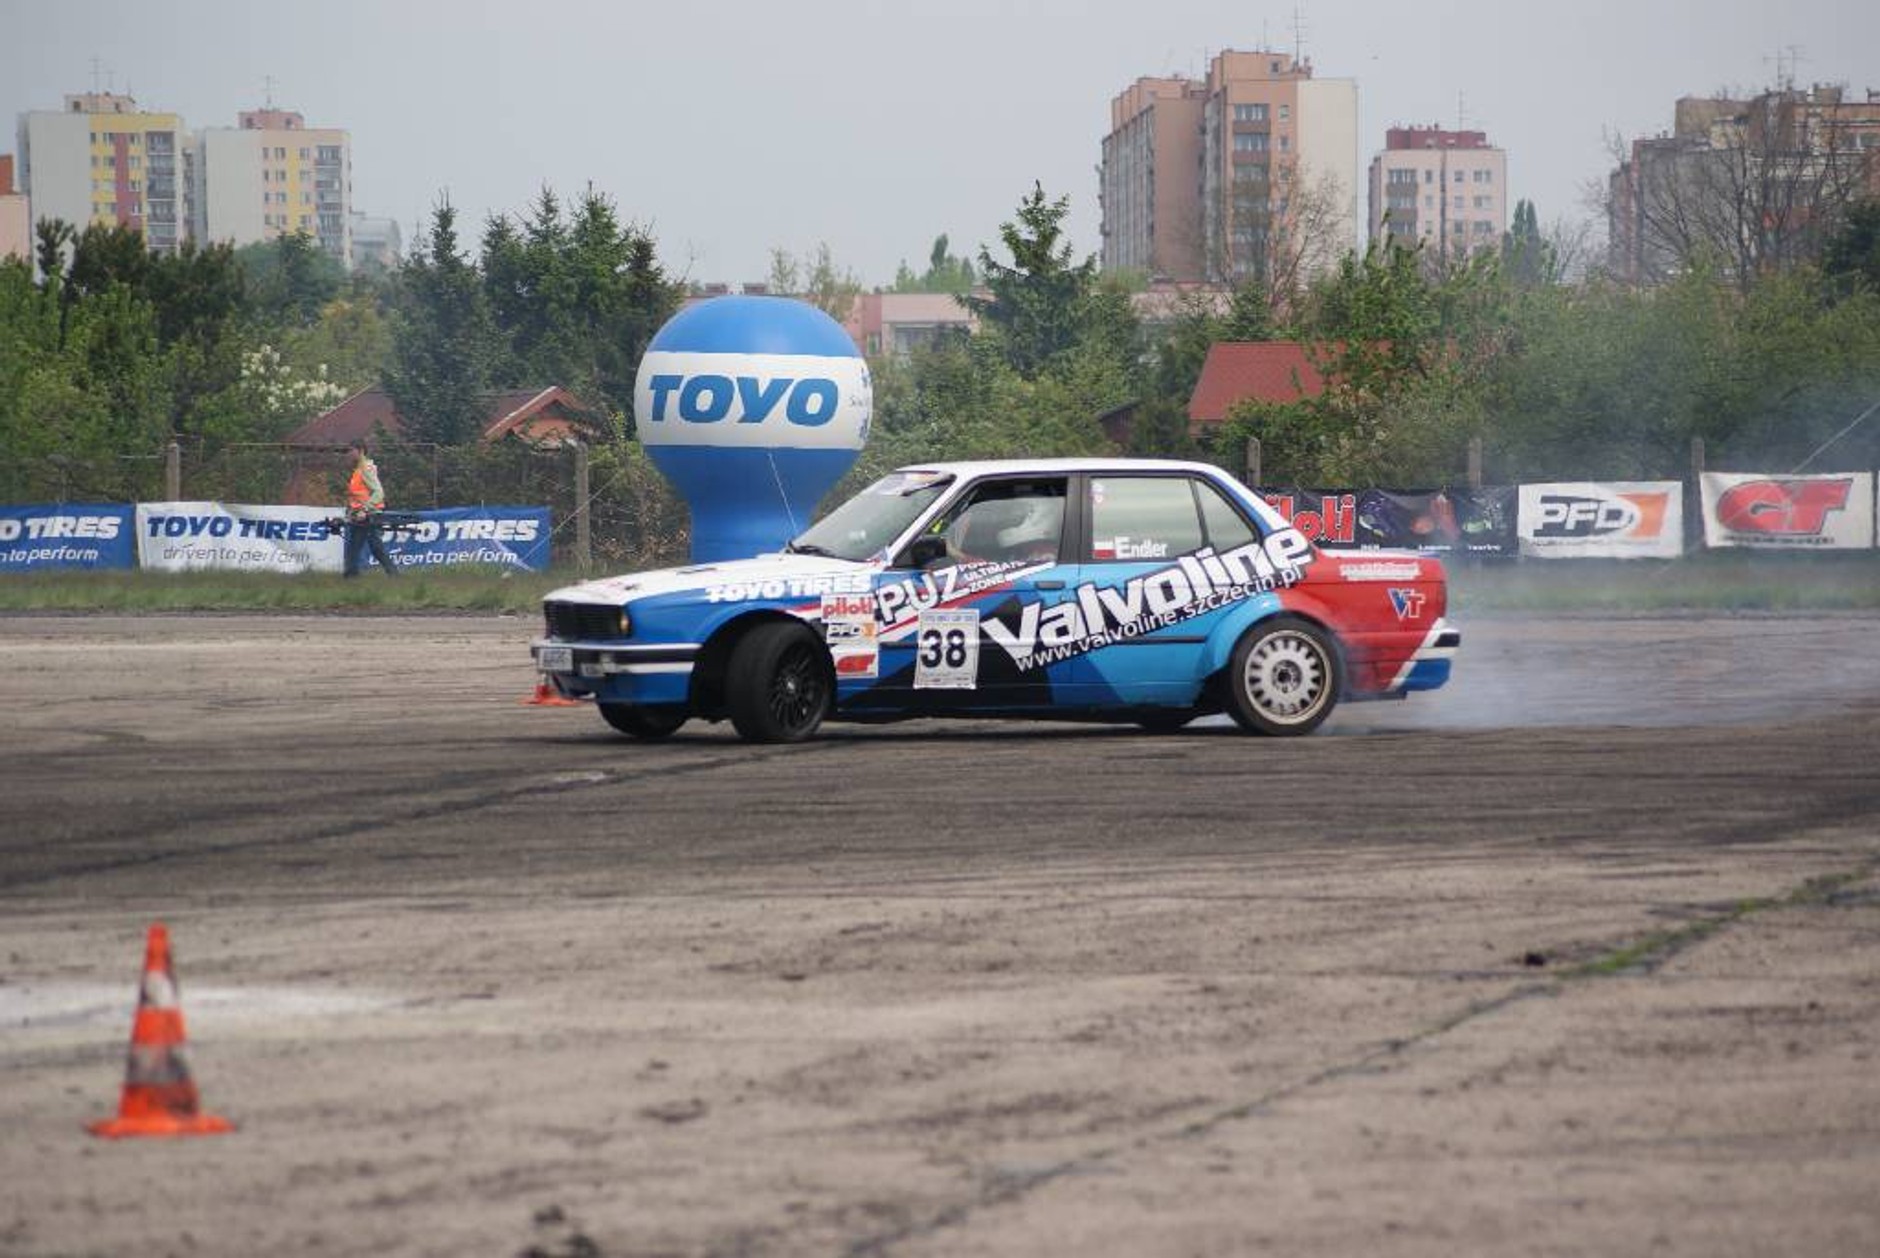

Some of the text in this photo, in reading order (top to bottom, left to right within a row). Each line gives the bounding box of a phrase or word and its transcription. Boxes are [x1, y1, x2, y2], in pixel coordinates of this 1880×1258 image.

[648, 374, 840, 427] TOYO
[25, 516, 122, 539] TIRES
[147, 516, 329, 541] TOYO TIRES
[1265, 495, 1355, 543] loti
[1533, 499, 1640, 532] PFD
[444, 519, 539, 541] TIRES
[9, 549, 27, 562] to
[27, 546, 99, 565] perform
[163, 544, 219, 560] driven
[426, 550, 443, 563] to
[446, 547, 517, 565] perform
[1115, 536, 1168, 559] Endler
[706, 574, 872, 603] TOYO TIRES
[877, 565, 970, 624] PUZ
[980, 528, 1314, 660] Valvoline
[823, 596, 873, 619] piloti
[1015, 563, 1304, 673] www.valvoline.szczecin.pl
[921, 627, 967, 669] 38
